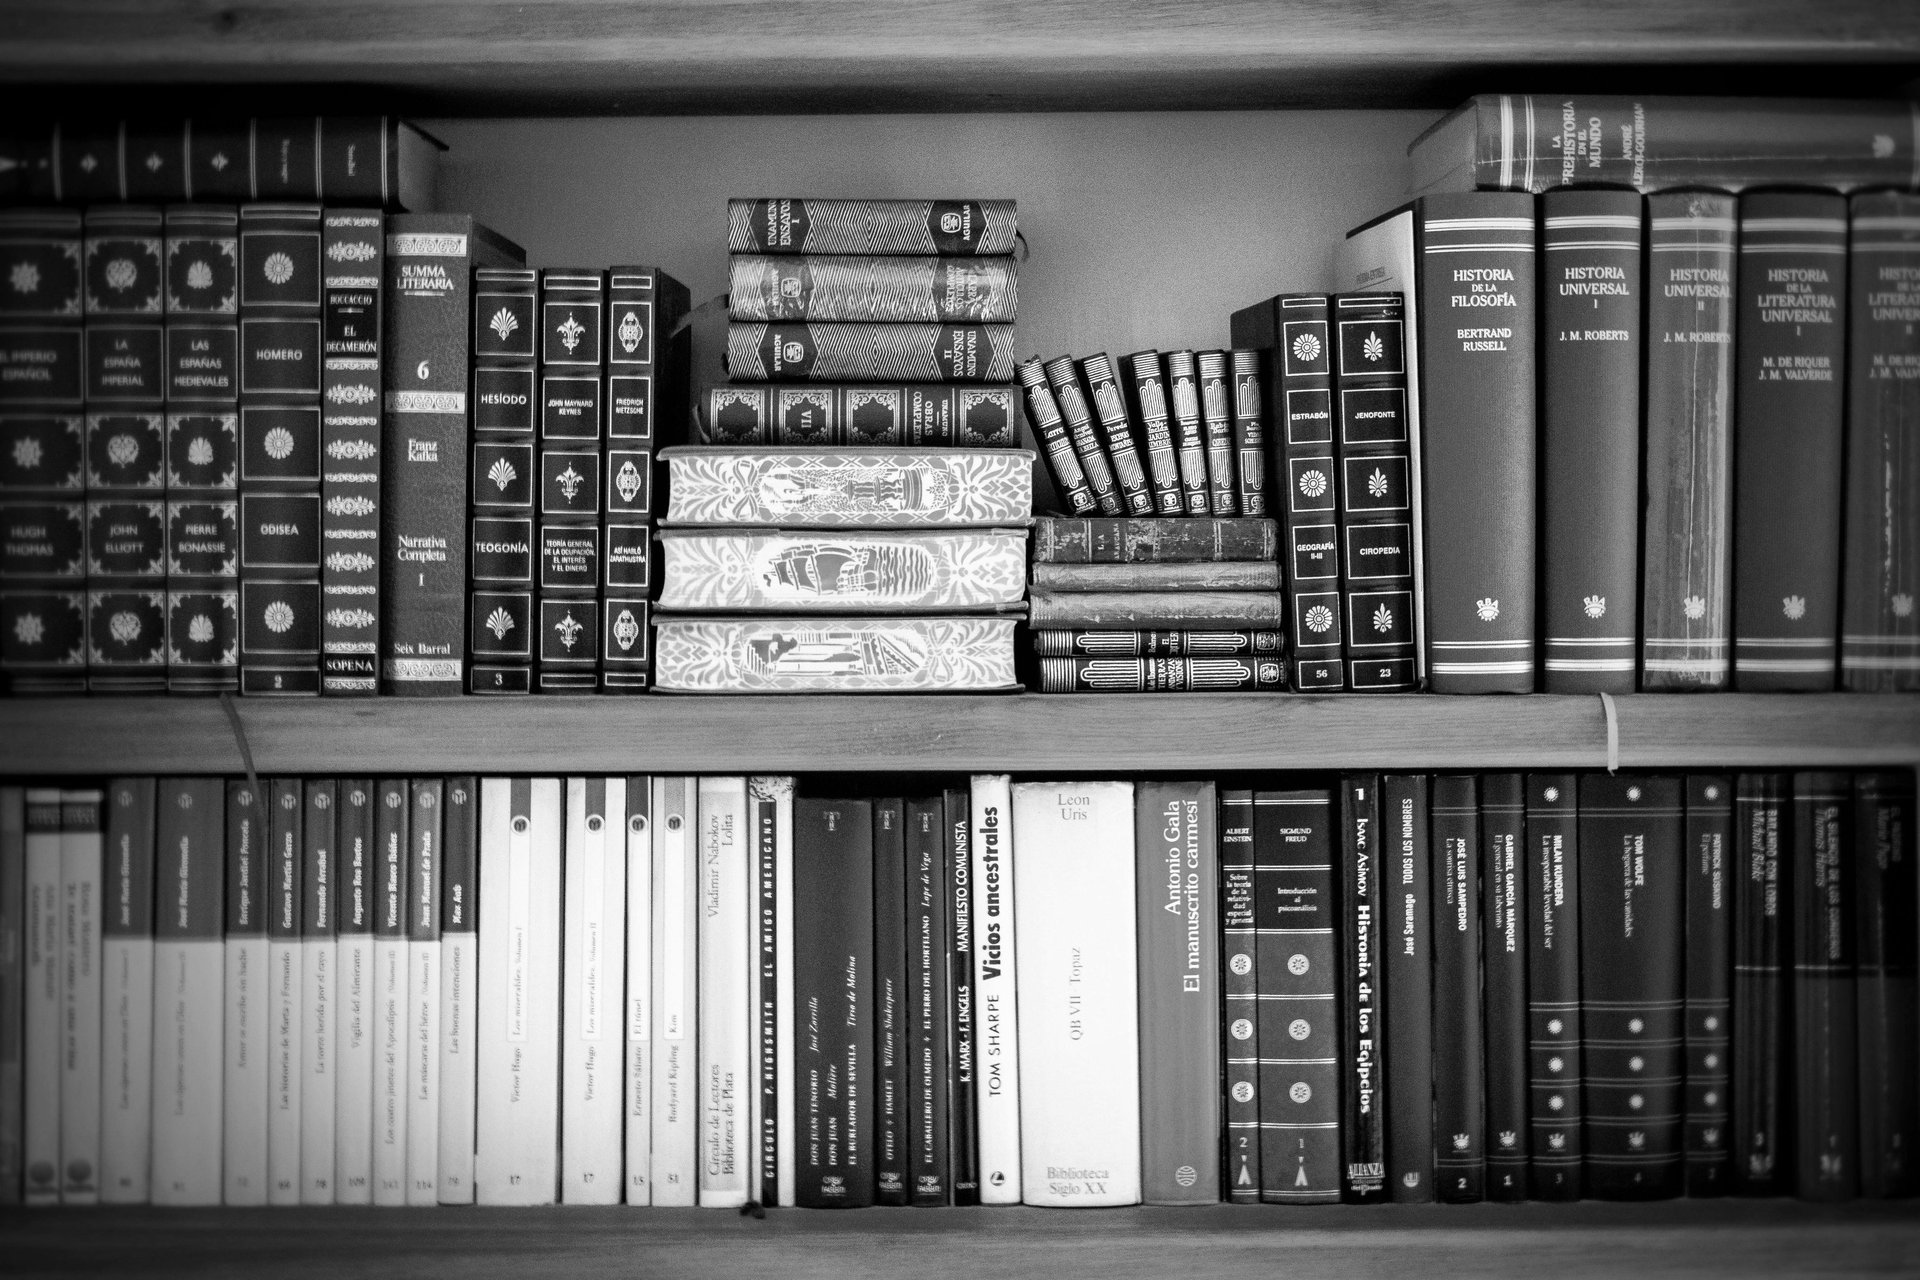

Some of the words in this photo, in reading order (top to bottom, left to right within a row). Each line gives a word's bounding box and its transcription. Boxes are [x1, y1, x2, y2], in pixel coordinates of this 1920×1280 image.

[1562, 101, 1576, 185] PREHISTORIA
[1589, 117, 1601, 168] MUNDO
[780, 199, 792, 246] ENSAYOS
[963, 204, 971, 241] AGUILAR
[402, 266, 446, 279] SUMMA
[1453, 269, 1514, 282] HISTORIA
[1565, 267, 1625, 280] HISTORIA
[1670, 269, 1730, 282] HISTORIA
[1768, 269, 1829, 282] HISTORIA
[397, 277, 454, 291] LITERARIA
[1471, 283, 1484, 292] DE
[1485, 283, 1497, 292] LA
[1559, 282, 1630, 296] UNIVERSAL
[1664, 285, 1731, 298] UNIVERSAL
[1786, 283, 1799, 293] DE
[1800, 283, 1812, 293] LA
[330, 294, 373, 306] BOCCACCIO
[1451, 292, 1517, 307] FILOSOFÍA
[1594, 298, 1598, 309] I
[1758, 295, 1836, 309] LITERATURA
[1762, 310, 1833, 323] UNIVERSAL
[343, 325, 356, 337] EL
[1457, 328, 1512, 339] BERTRAND
[1560, 332, 1565, 341] J.
[1570, 331, 1582, 341] M.
[1584, 330, 1629, 341] ROBERTS
[191, 340, 209, 350] LAS
[326, 339, 377, 353] DECAMERÓN
[1463, 341, 1507, 351] RUSSELL
[256, 348, 303, 361] HOMERO
[953, 330, 964, 377] ENSAYOS
[967, 330, 976, 377] UNAMUNO
[180, 355, 222, 369] ESPAÑAS
[416, 360, 430, 380] 6
[175, 375, 229, 387] MEDIEVALES
[481, 393, 527, 405] HESÍODO
[548, 400, 563, 408] JOHN
[564, 400, 593, 408] MAYNARD
[616, 398, 644, 406] FRIEDRICH
[559, 408, 582, 416] KEYNES
[616, 406, 644, 414] NIETZSCHE
[1291, 411, 1328, 420] ESTRABÓN
[1354, 411, 1395, 419] JENOFONTE
[801, 409, 812, 429] VII
[925, 400, 933, 436] OBRAS
[408, 439, 438, 452] Franz
[408, 450, 438, 462] Kafka
[186, 525, 218, 535] PIERRE
[260, 524, 299, 535] ODISEA
[179, 542, 226, 553] BONASSIE
[399, 535, 447, 549] Narrativa
[476, 541, 529, 554] TEOGONÍA
[1297, 541, 1335, 552] GEOGRAFÍA
[398, 548, 447, 563] Completa
[614, 546, 623, 554] ASÍ
[623, 546, 642, 554] HABLÓ
[1359, 546, 1400, 556] CIROPEDIA
[610, 555, 646, 563] ZARATHUSTRA
[394, 643, 416, 655] Seix
[418, 643, 450, 655] Barral
[326, 659, 374, 672] SOPENA
[1379, 669, 1391, 677] 23
[495, 673, 503, 685] 3
[1316, 669, 1328, 678] 56
[1058, 793, 1090, 806] Leon
[1061, 808, 1088, 821] Uris
[1163, 800, 1180, 843] Gala
[1402, 798, 1413, 838] NOMBRES
[721, 814, 734, 846] Lolita
[1182, 800, 1199, 869] carmesí
[1226, 827, 1250, 835] ALBERT
[1279, 827, 1312, 835] SIGMUND
[707, 814, 719, 865] Nabokov
[1634, 834, 1644, 855] TOM
[955, 821, 967, 886] COMUNISTA
[1402, 839, 1413, 856] LOS
[1456, 837, 1467, 859] JOSÉ
[1505, 834, 1514, 872] GABRIEL
[1553, 834, 1563, 863] MILAN
[763, 818, 773, 899] AMERICANO
[979, 807, 999, 917] ancestrales
[1402, 858, 1413, 885] TODOS
[1457, 860, 1466, 880] LUIS
[1634, 856, 1644, 886] WOLFE
[1164, 847, 1181, 916] Antonio
[1554, 864, 1563, 906] KUNDERA
[707, 869, 719, 918] Vladimir
[1505, 873, 1516, 907] GARCÍA
[1457, 881, 1467, 931] SAMPEDRO
[956, 887, 969, 952] MANIFIESTO
[1184, 873, 1200, 970] manuscrito
[1403, 893, 1416, 936] Saramago
[763, 909, 773, 953] AMIGO
[1504, 908, 1516, 952] MÁRQUEZ
[1357, 905, 1371, 978] Historia
[1403, 936, 1415, 956] José
[982, 923, 1001, 981] Vicios
[764, 963, 773, 977] EL
[1069, 946, 1083, 985] Topaz
[1183, 974, 1200, 993] El
[958, 986, 970, 1022] ENGELS
[1070, 995, 1081, 1016] VII
[669, 1014, 678, 1033] Kim
[987, 994, 1000, 1056] SHARPE
[1359, 1007, 1373, 1034] los
[1069, 1020, 1083, 1041] QB
[764, 1001, 774, 1080] HIGHSMITH
[668, 1045, 679, 1080] Kipling
[959, 1040, 971, 1070] MARX
[960, 1072, 971, 1082] K.
[988, 1062, 1001, 1098] TOM
[1357, 1039, 1373, 1114] Egipcios
[708, 1064, 720, 1112] Lectores
[722, 1072, 734, 1099] Plata
[722, 1103, 734, 1116] de
[708, 1116, 720, 1129] de
[722, 1120, 734, 1175] Biblioteca
[1239, 1136, 1248, 1148] 2
[707, 1132, 720, 1176] Círculo
[1046, 1167, 1110, 1181] Biblioteca
[1049, 1182, 1081, 1197] Siglo
[1084, 1182, 1107, 1195] XX
